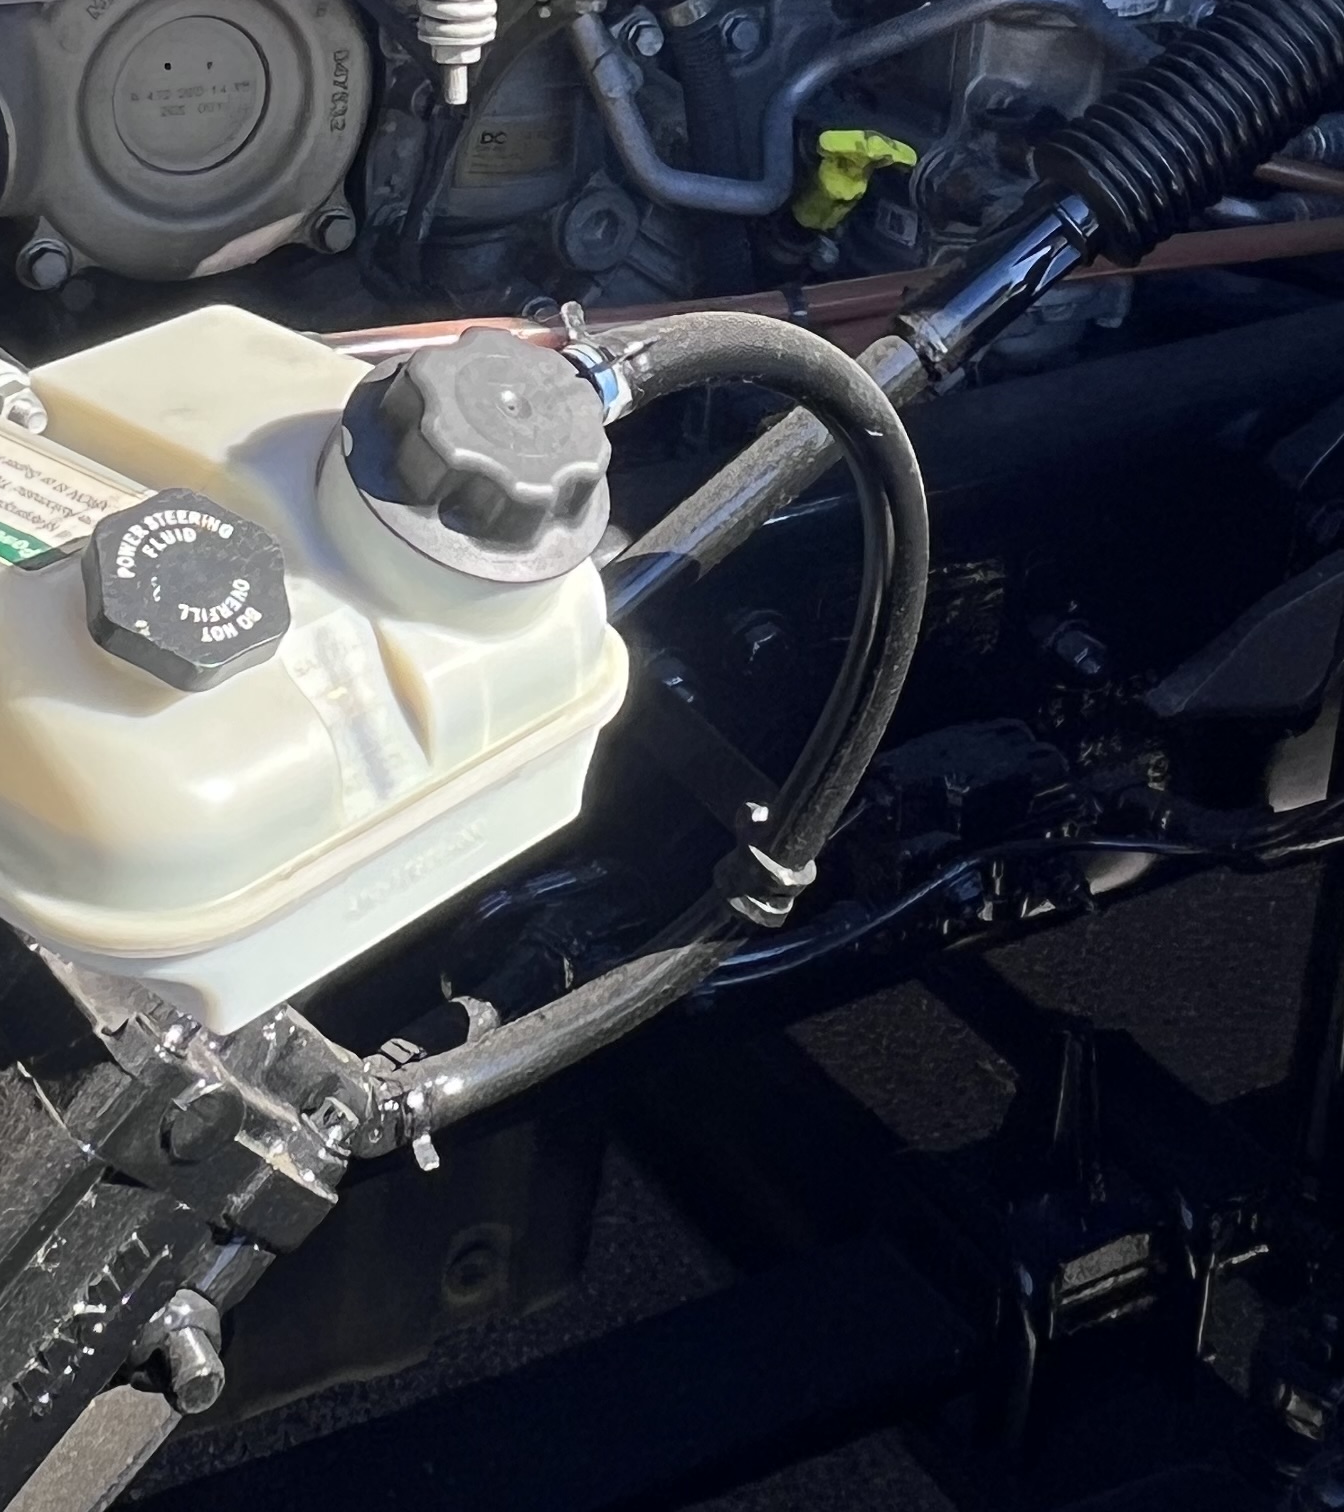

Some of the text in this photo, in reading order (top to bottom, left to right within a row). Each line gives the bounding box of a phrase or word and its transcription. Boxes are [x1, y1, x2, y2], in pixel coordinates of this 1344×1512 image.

[115, 508, 235, 579] POWER STEERING
[141, 526, 198, 559] FLUID
[177, 577, 252, 624] OVERFILL
[200, 624, 239, 643] NOT
